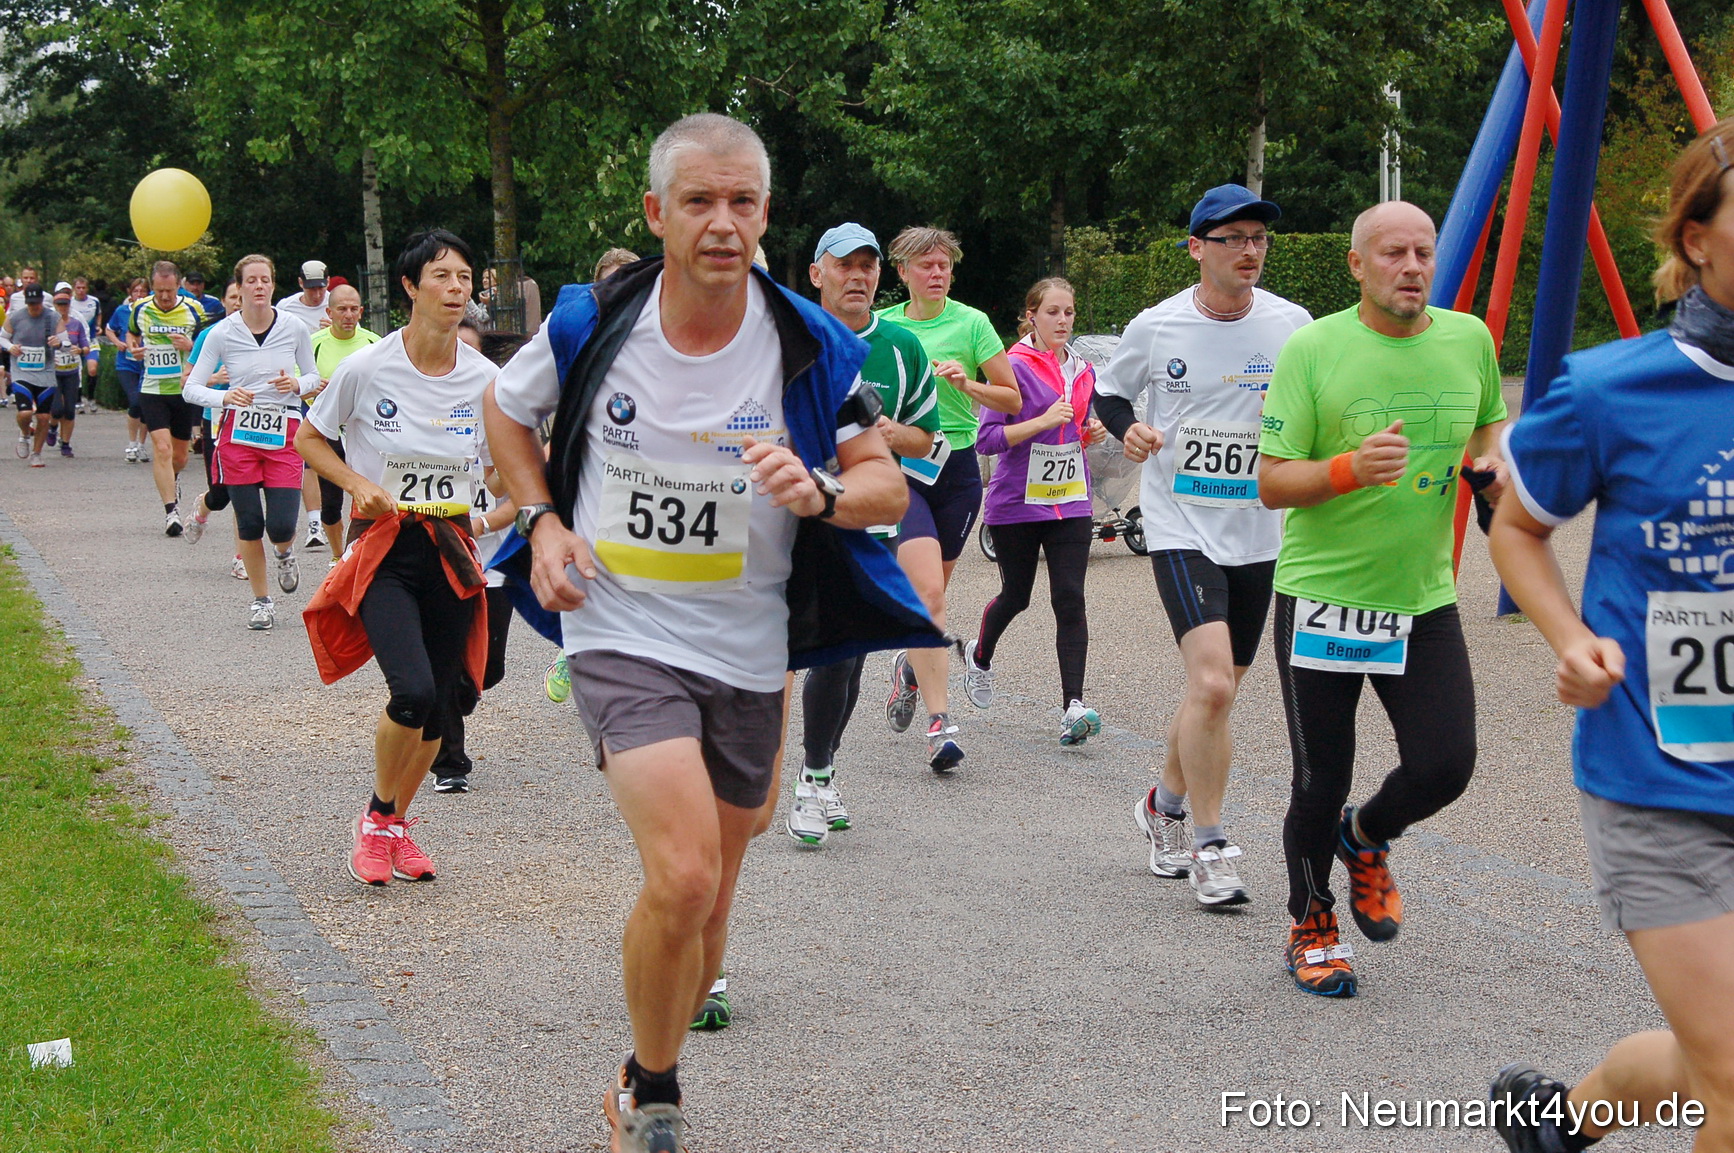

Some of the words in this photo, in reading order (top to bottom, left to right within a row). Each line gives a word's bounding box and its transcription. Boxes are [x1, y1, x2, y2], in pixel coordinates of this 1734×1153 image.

[20, 353, 43, 362] 2177
[149, 352, 178, 366] 3103
[239, 410, 283, 432] 2034
[374, 420, 402, 428] PARTL
[602, 425, 640, 443] PARTL
[1180, 426, 1210, 437] PARTL
[1211, 429, 1256, 440] Neumarkt
[602, 436, 640, 451] Neumarkt
[1031, 448, 1055, 457] PARTL
[1183, 440, 1259, 475] 2567
[387, 460, 417, 470] PARTL
[418, 461, 461, 472] Neumarkt
[1042, 458, 1076, 481] 276
[606, 463, 650, 485] PARTL
[653, 475, 725, 493] Neumarkt
[399, 473, 455, 501] 216
[1192, 480, 1247, 496] Reinhard
[627, 490, 719, 547] 534
[1306, 599, 1401, 637] 2104
[1652, 609, 1717, 626] PARTL
[1326, 641, 1372, 659] Benno
